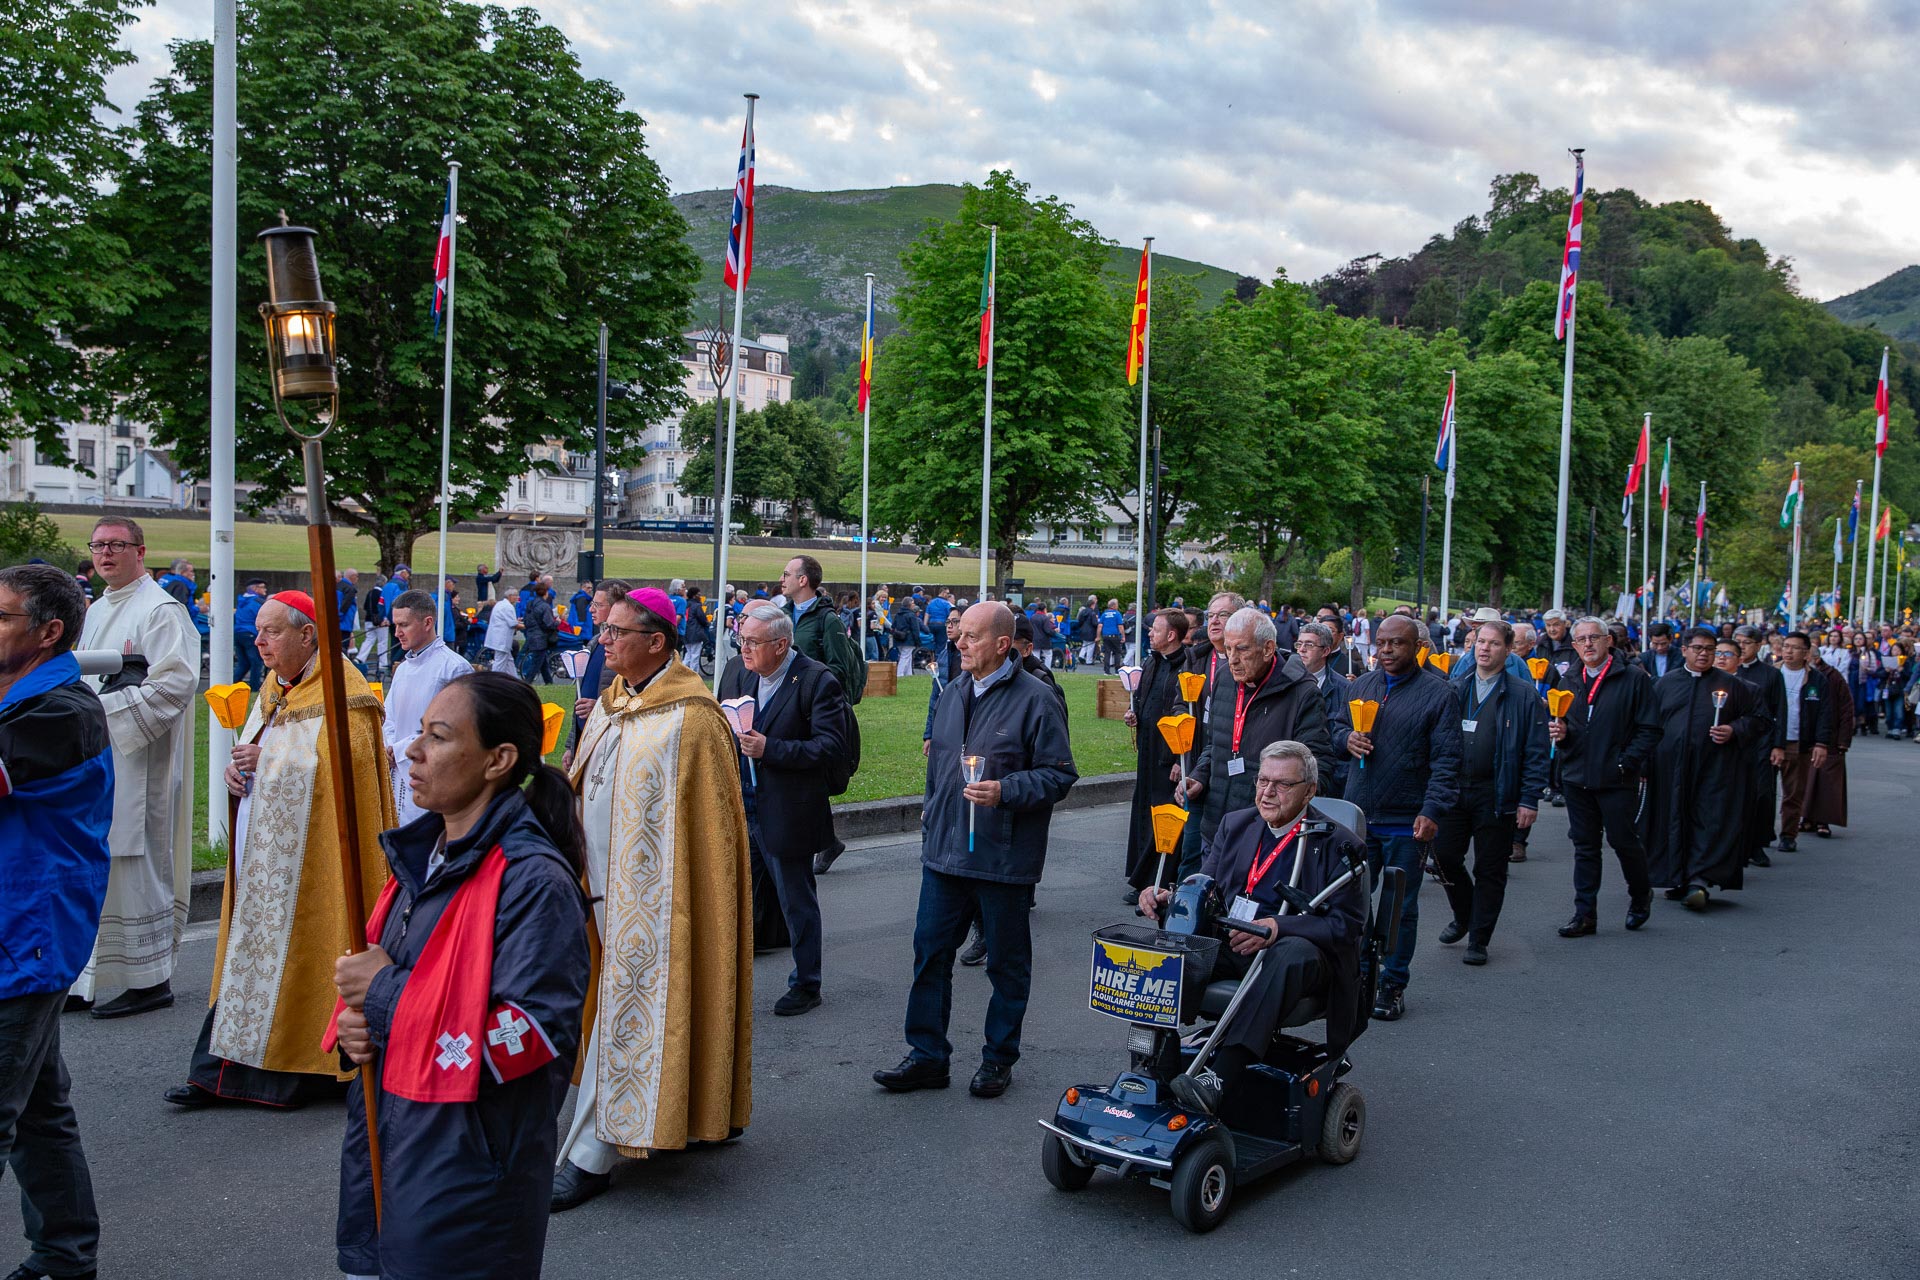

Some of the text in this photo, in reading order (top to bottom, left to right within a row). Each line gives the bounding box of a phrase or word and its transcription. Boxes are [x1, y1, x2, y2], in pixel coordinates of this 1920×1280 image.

[1094, 966, 1178, 998] HIRE ME
[1119, 967, 1144, 976] LOURDES
[1092, 991, 1177, 1014] ALQUILARME HUUR MIJ
[1094, 984, 1175, 1007] AFFITTAMI LOUEZ MOI
[1097, 1001, 1111, 1011] 0033
